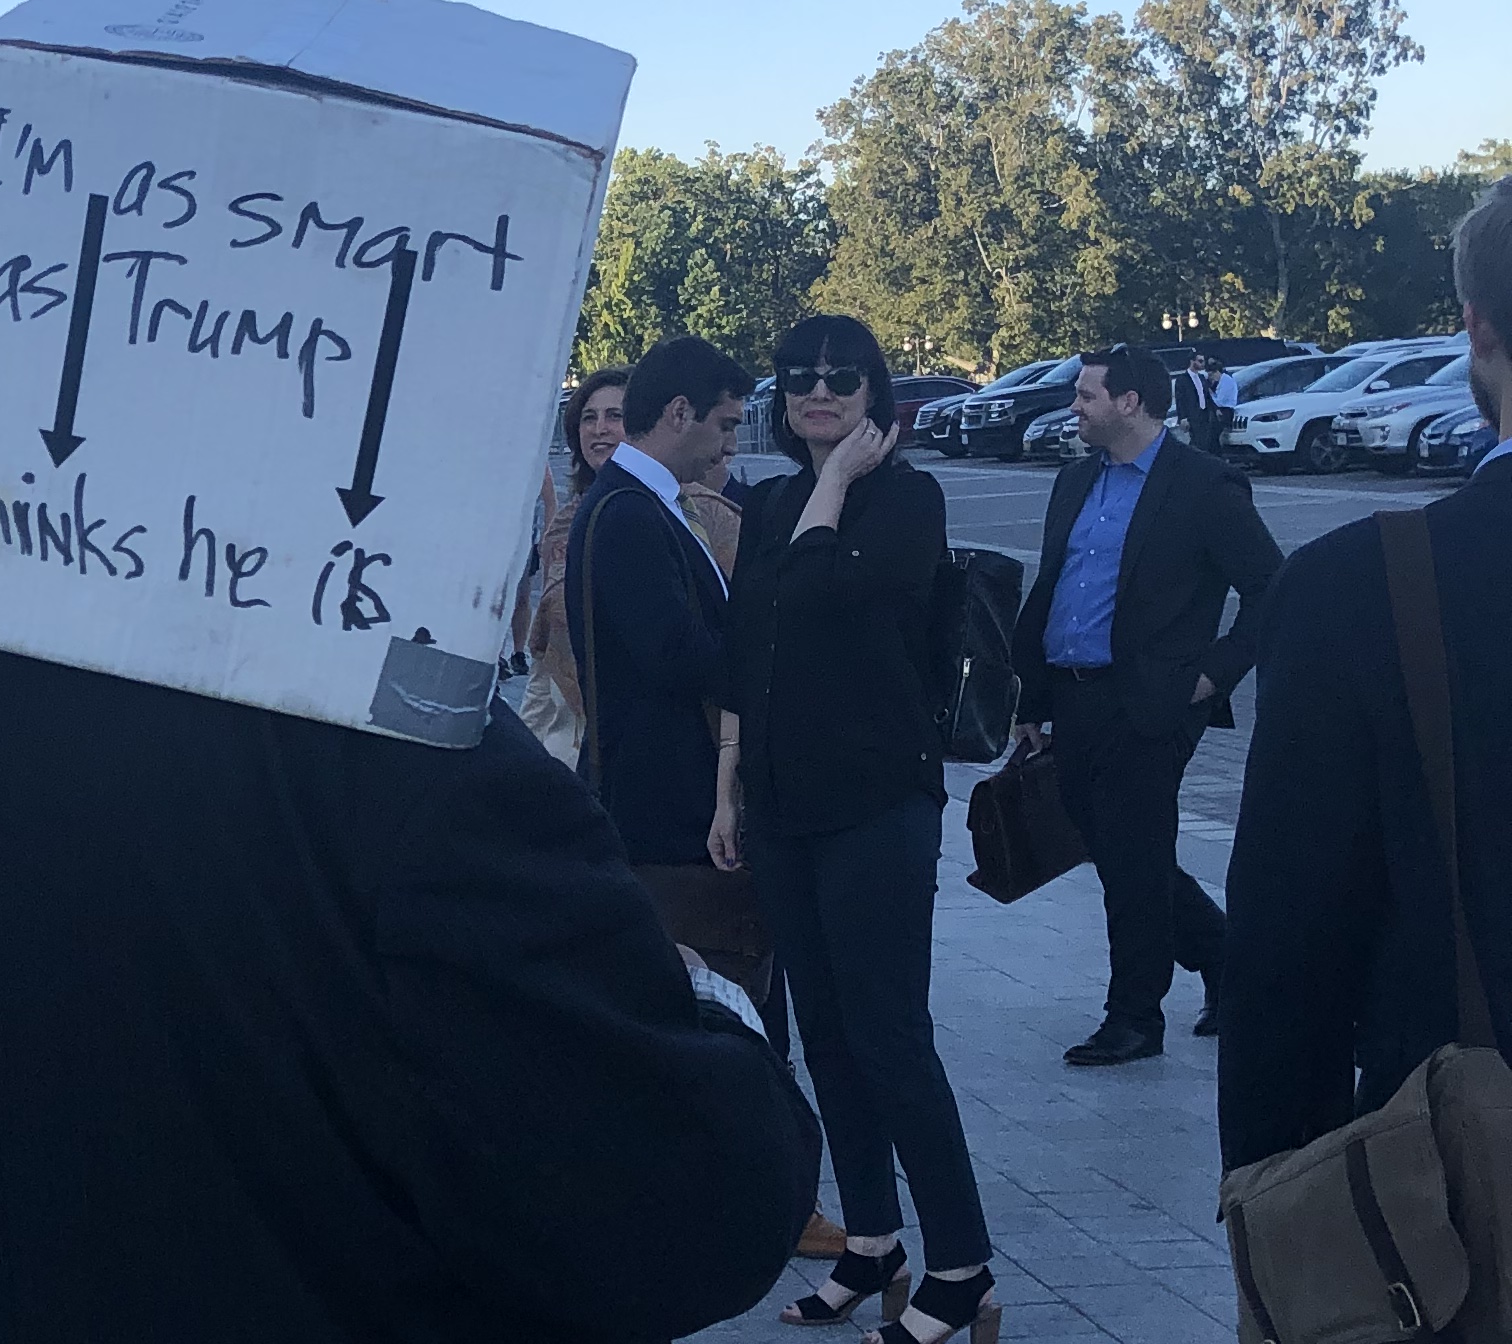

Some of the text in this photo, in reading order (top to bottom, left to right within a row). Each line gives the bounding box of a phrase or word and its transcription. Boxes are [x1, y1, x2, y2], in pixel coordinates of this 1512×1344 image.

[112, 160, 198, 229] as
[102, 250, 352, 419] Trump
[178, 494, 271, 609] he
